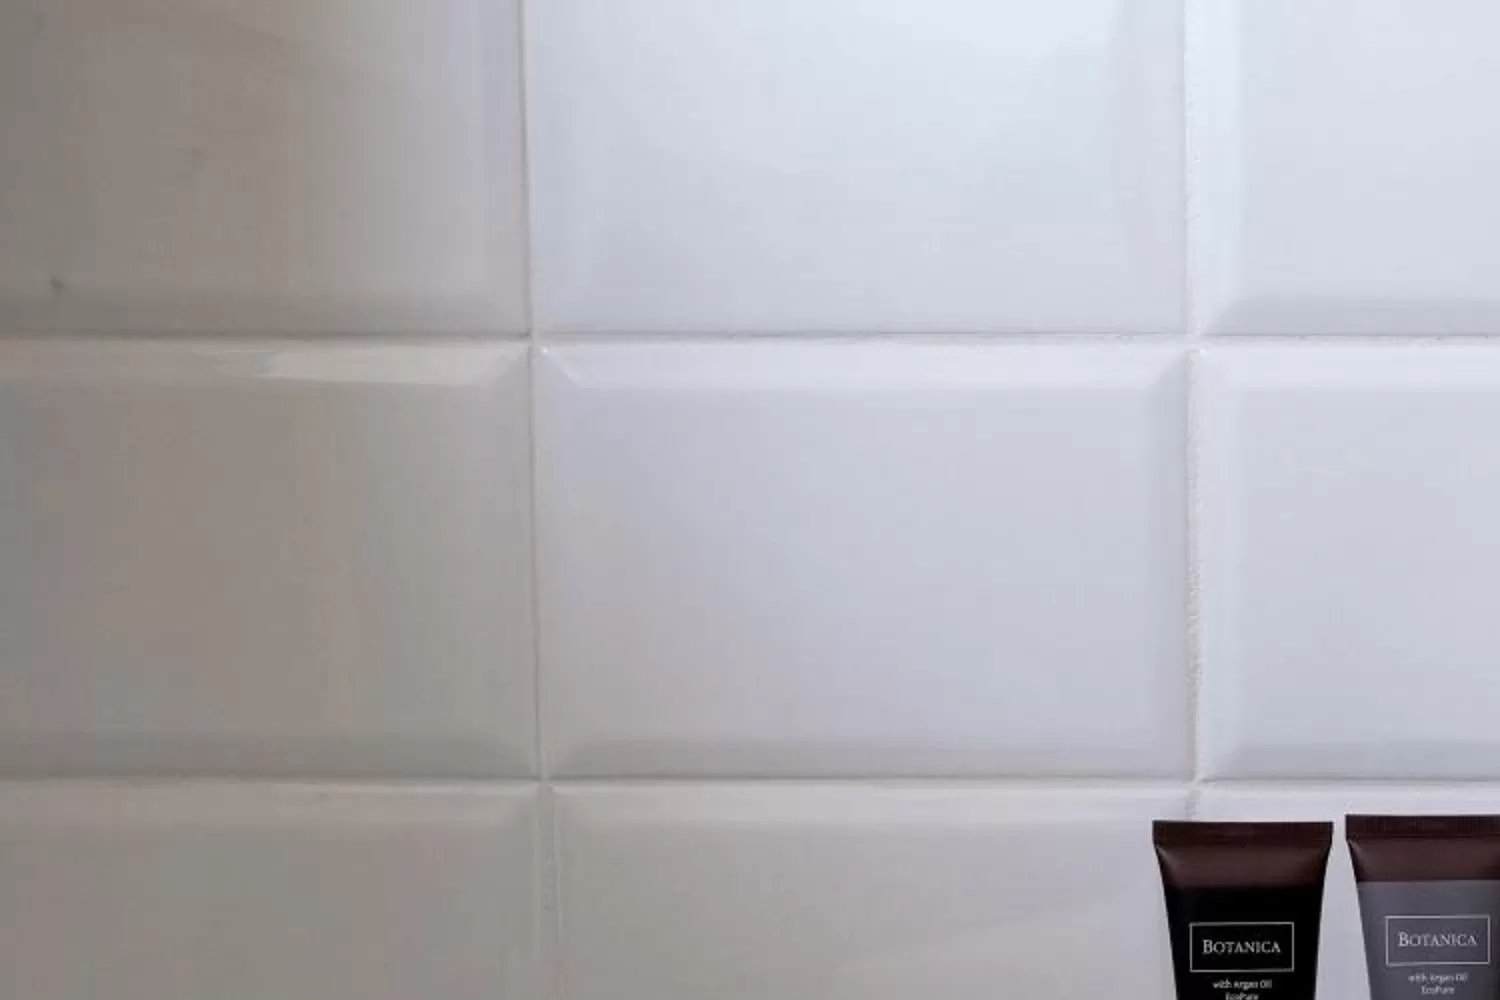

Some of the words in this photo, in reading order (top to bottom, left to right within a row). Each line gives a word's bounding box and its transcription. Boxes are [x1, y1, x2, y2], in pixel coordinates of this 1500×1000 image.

[1407, 971, 1428, 983] with
[1430, 972, 1454, 985] Argan
[1212, 978, 1232, 988] with
[1233, 979, 1258, 990] Argan
[1260, 979, 1273, 989] Oil
[1225, 991, 1259, 1000] EcoPure
[1421, 985, 1455, 995] EcoPure
